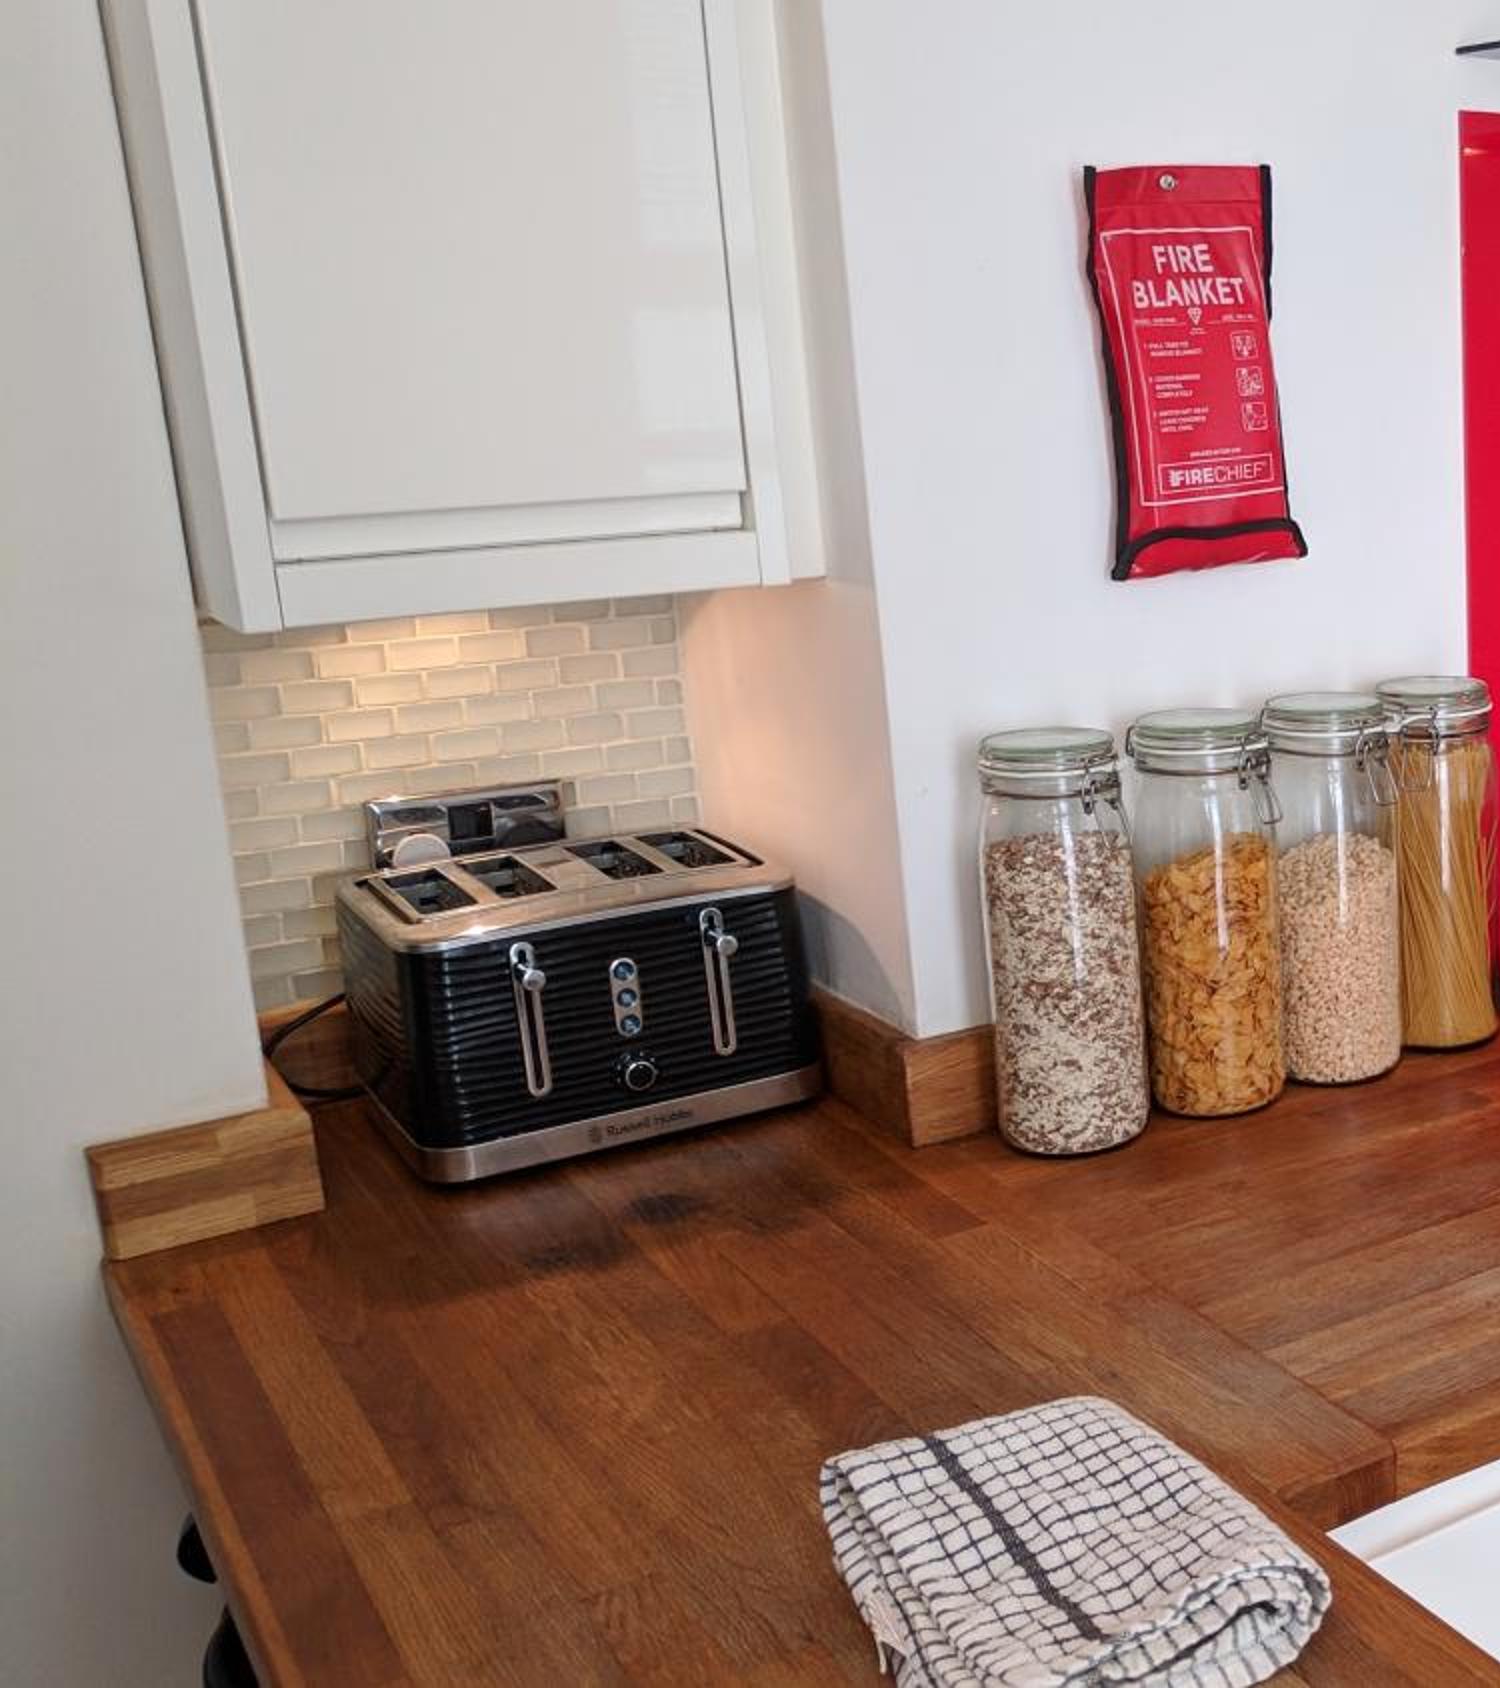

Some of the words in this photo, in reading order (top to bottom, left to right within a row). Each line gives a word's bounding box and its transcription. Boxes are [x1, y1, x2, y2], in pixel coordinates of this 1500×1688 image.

[1152, 244, 1213, 274] FIRE
[1133, 278, 1245, 308] BLANKET
[1170, 462, 1263, 487] FIRECHIEF
